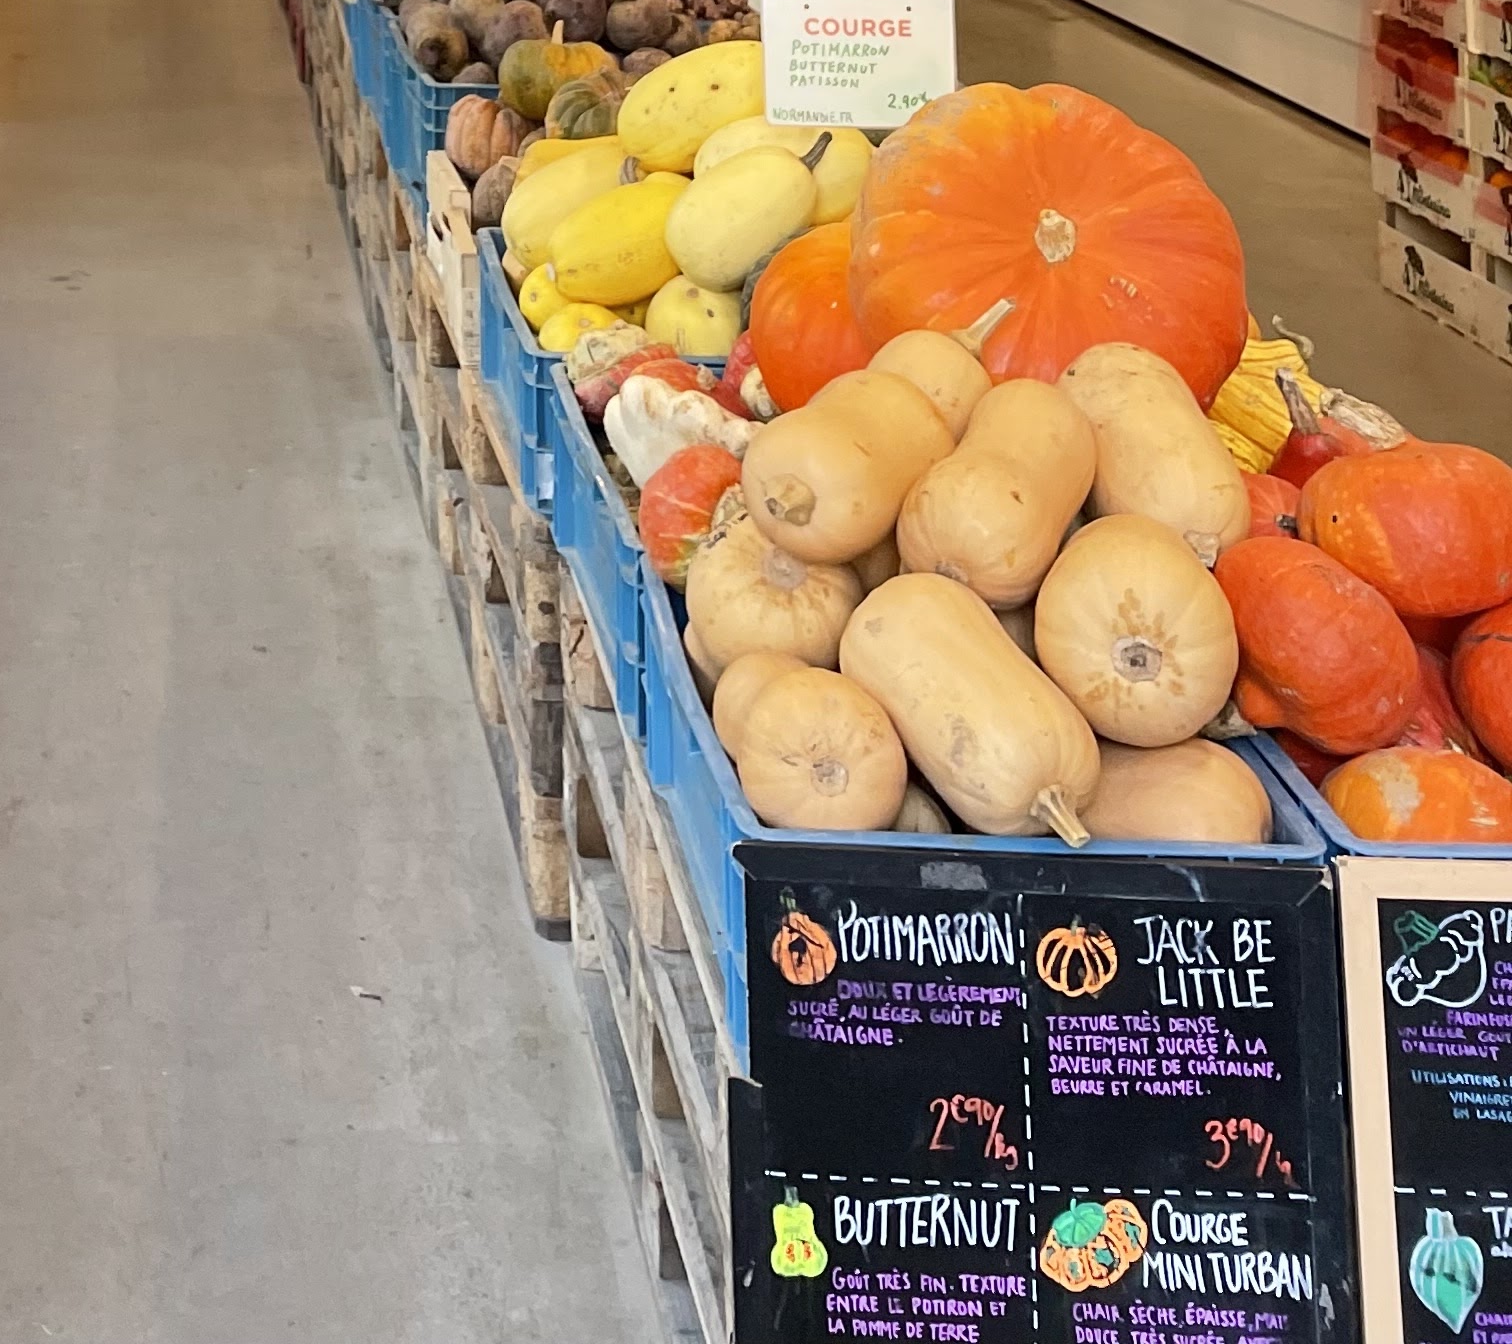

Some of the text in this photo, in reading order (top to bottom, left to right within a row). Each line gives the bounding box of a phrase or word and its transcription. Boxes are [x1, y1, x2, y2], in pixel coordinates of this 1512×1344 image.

[804, 17, 912, 38] COURGE
[791, 39, 890, 57] POTIMARRON
[789, 59, 878, 75] BUTTERNUT
[789, 74, 860, 88] PATISSON
[838, 900, 1015, 967] POTIMARRON
[1134, 914, 1276, 965] JACK BE
[892, 982, 913, 1000] ET
[1157, 965, 1274, 1009] LITTLE
[848, 1004, 868, 1022] AU
[930, 1004, 975, 1027] GOÛT
[980, 1010, 1003, 1027] DE
[1046, 1015, 1120, 1032] TEXTURE
[1123, 1010, 1161, 1033] TRÈS
[1048, 1036, 1149, 1056] NETTEMENT
[1156, 1033, 1219, 1056] SUCRÉE
[1246, 1037, 1268, 1055] LA
[1402, 1040, 1499, 1062] D'ARTICHAUT
[1048, 1054, 1114, 1075] SAVEUR
[1118, 1058, 1157, 1077] FINE
[1162, 1059, 1181, 1076] DE
[1051, 1078, 1105, 1096] BEURRE
[1111, 1080, 1128, 1096] ET
[834, 1193, 1020, 1252] BUTTERNUT
[1151, 1198, 1249, 1247] COURGE
[876, 1268, 911, 1291] TRÈS
[958, 1274, 1027, 1297] TEXTURE
[1143, 1251, 1313, 1301] MINI TURBAN
[826, 1293, 1006, 1317] ENTRE LE POTIRON ET
[828, 1318, 980, 1343] LA POMME DE TERRE
[1074, 1325, 1119, 1344] DOUCE
